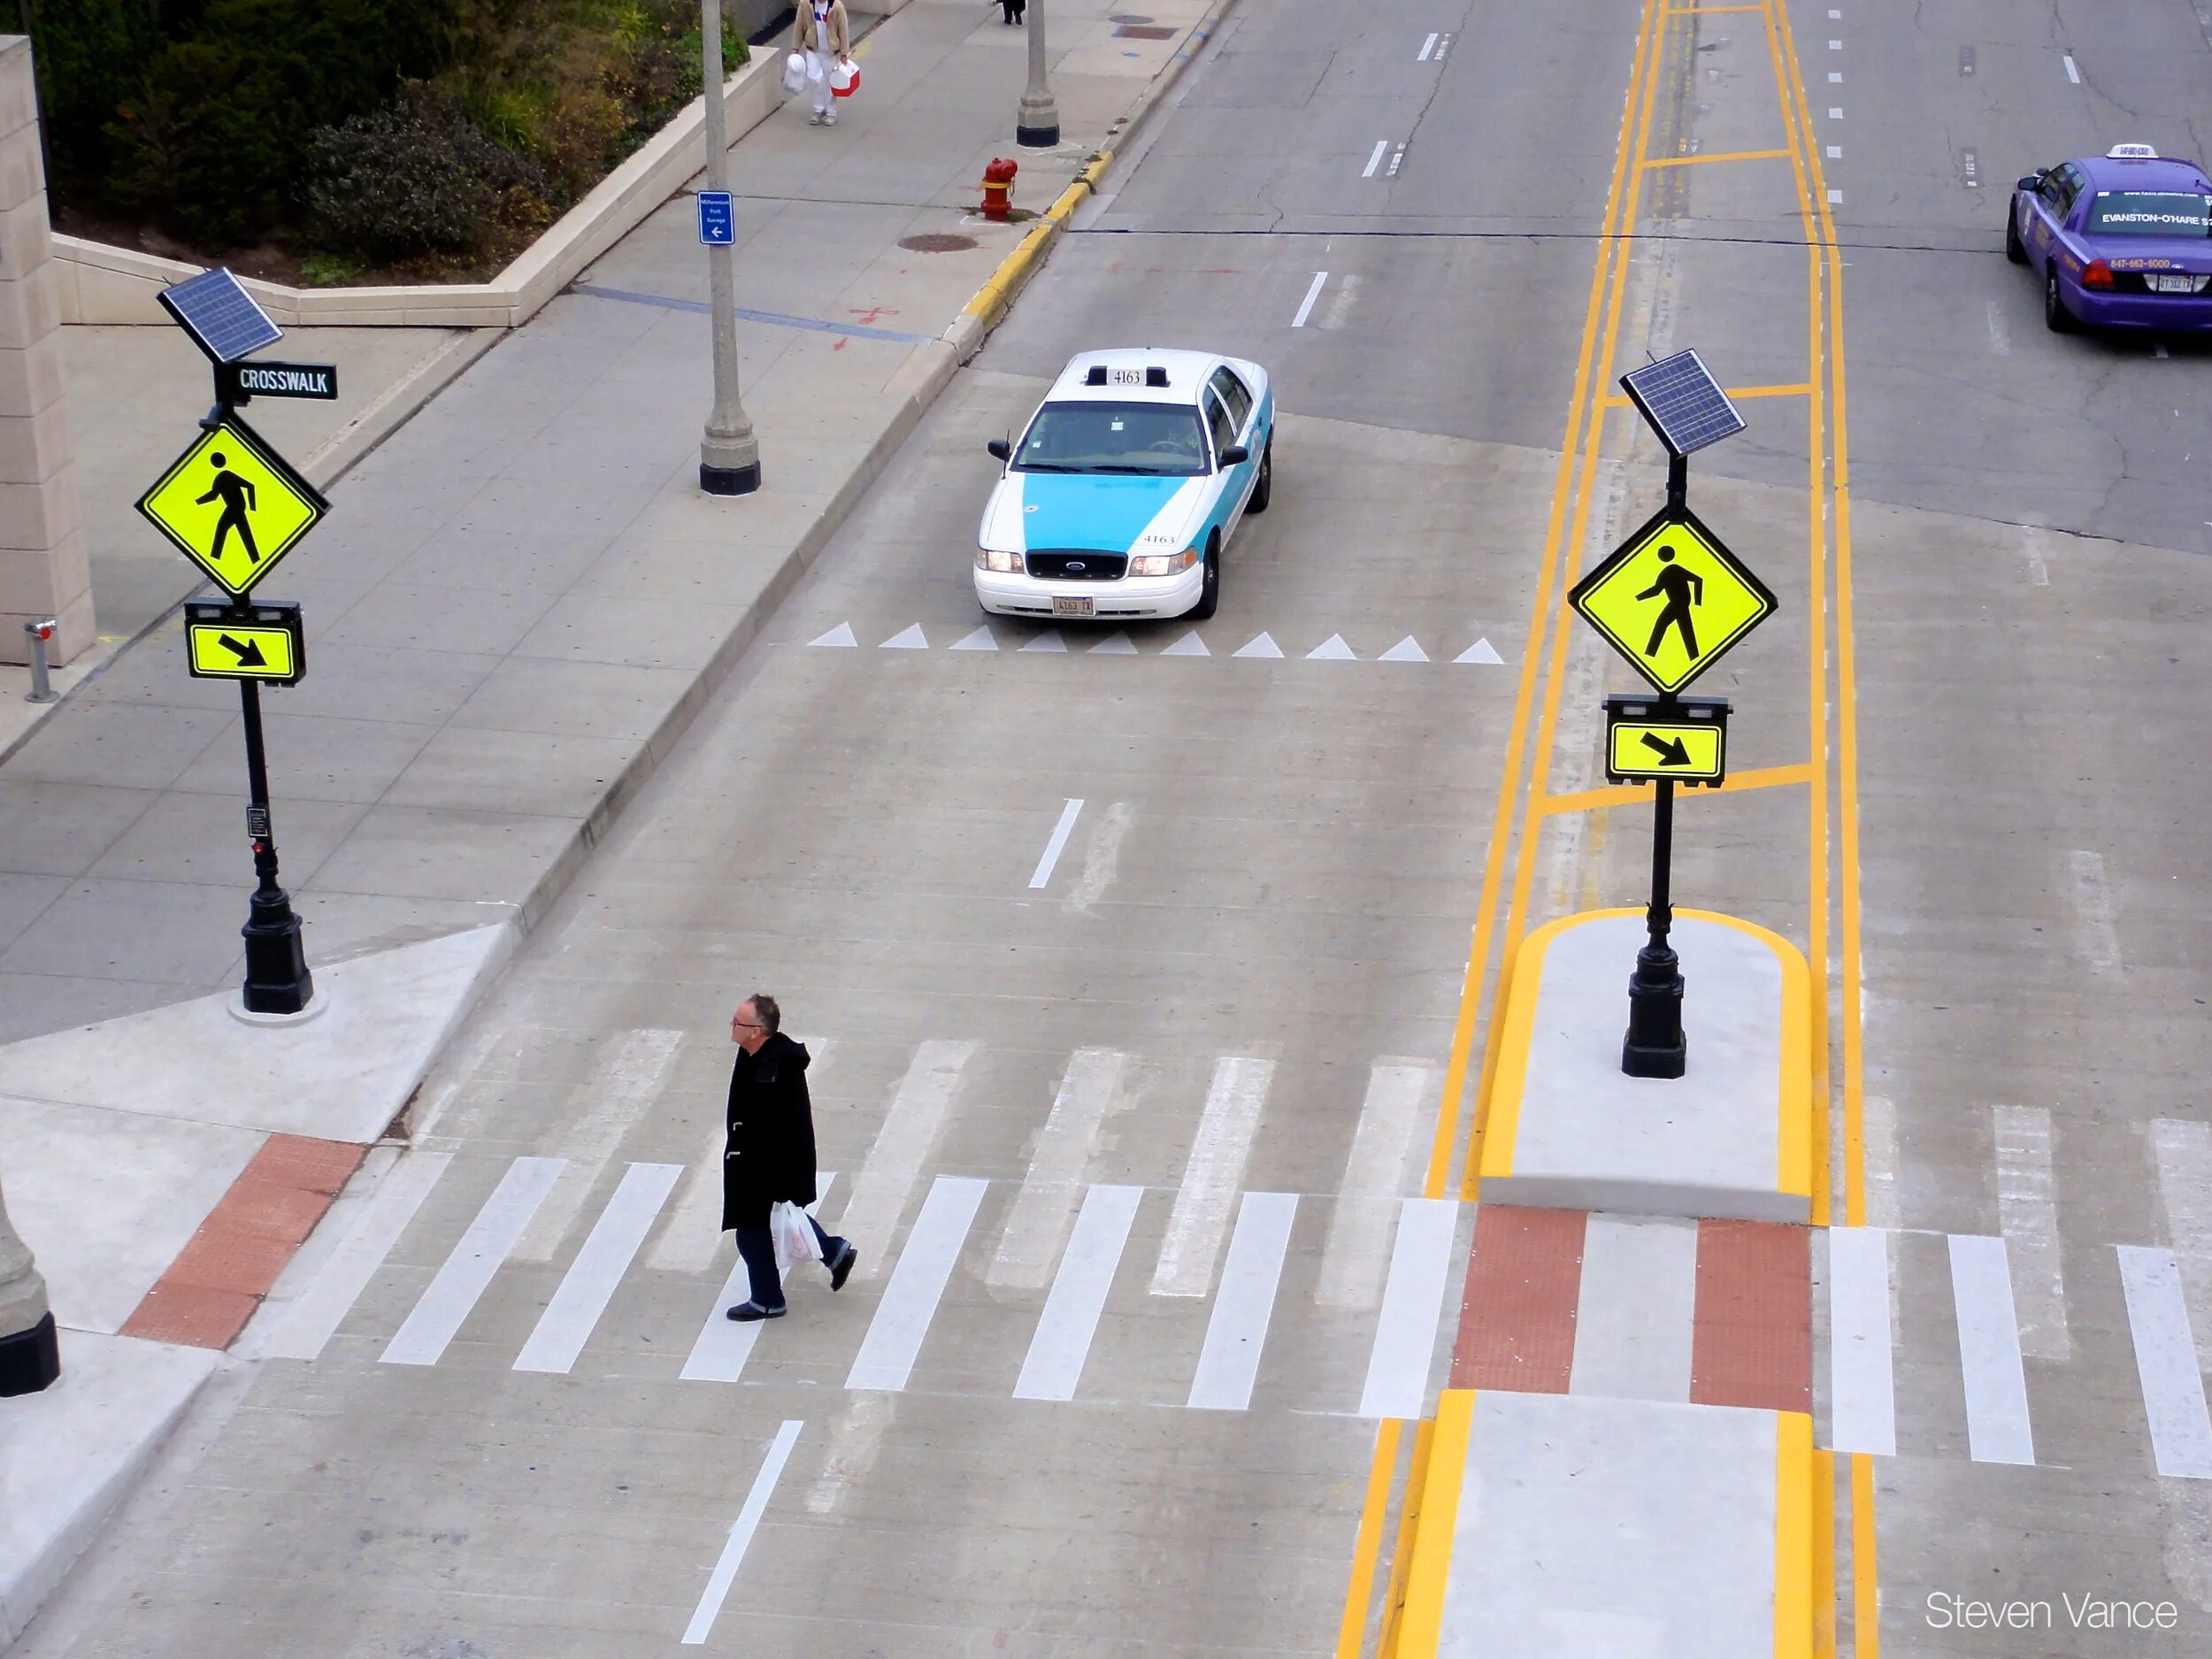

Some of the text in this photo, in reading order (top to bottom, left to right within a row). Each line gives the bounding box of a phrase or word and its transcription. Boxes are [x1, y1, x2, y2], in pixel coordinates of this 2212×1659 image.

[2102, 213, 2200, 225] EVANSTON-O'HARE
[240, 369, 327, 392] CROSSWALK
[1114, 371, 1140, 383] 4163
[1143, 535, 1174, 544] 4163
[1059, 601, 1078, 611] 4163
